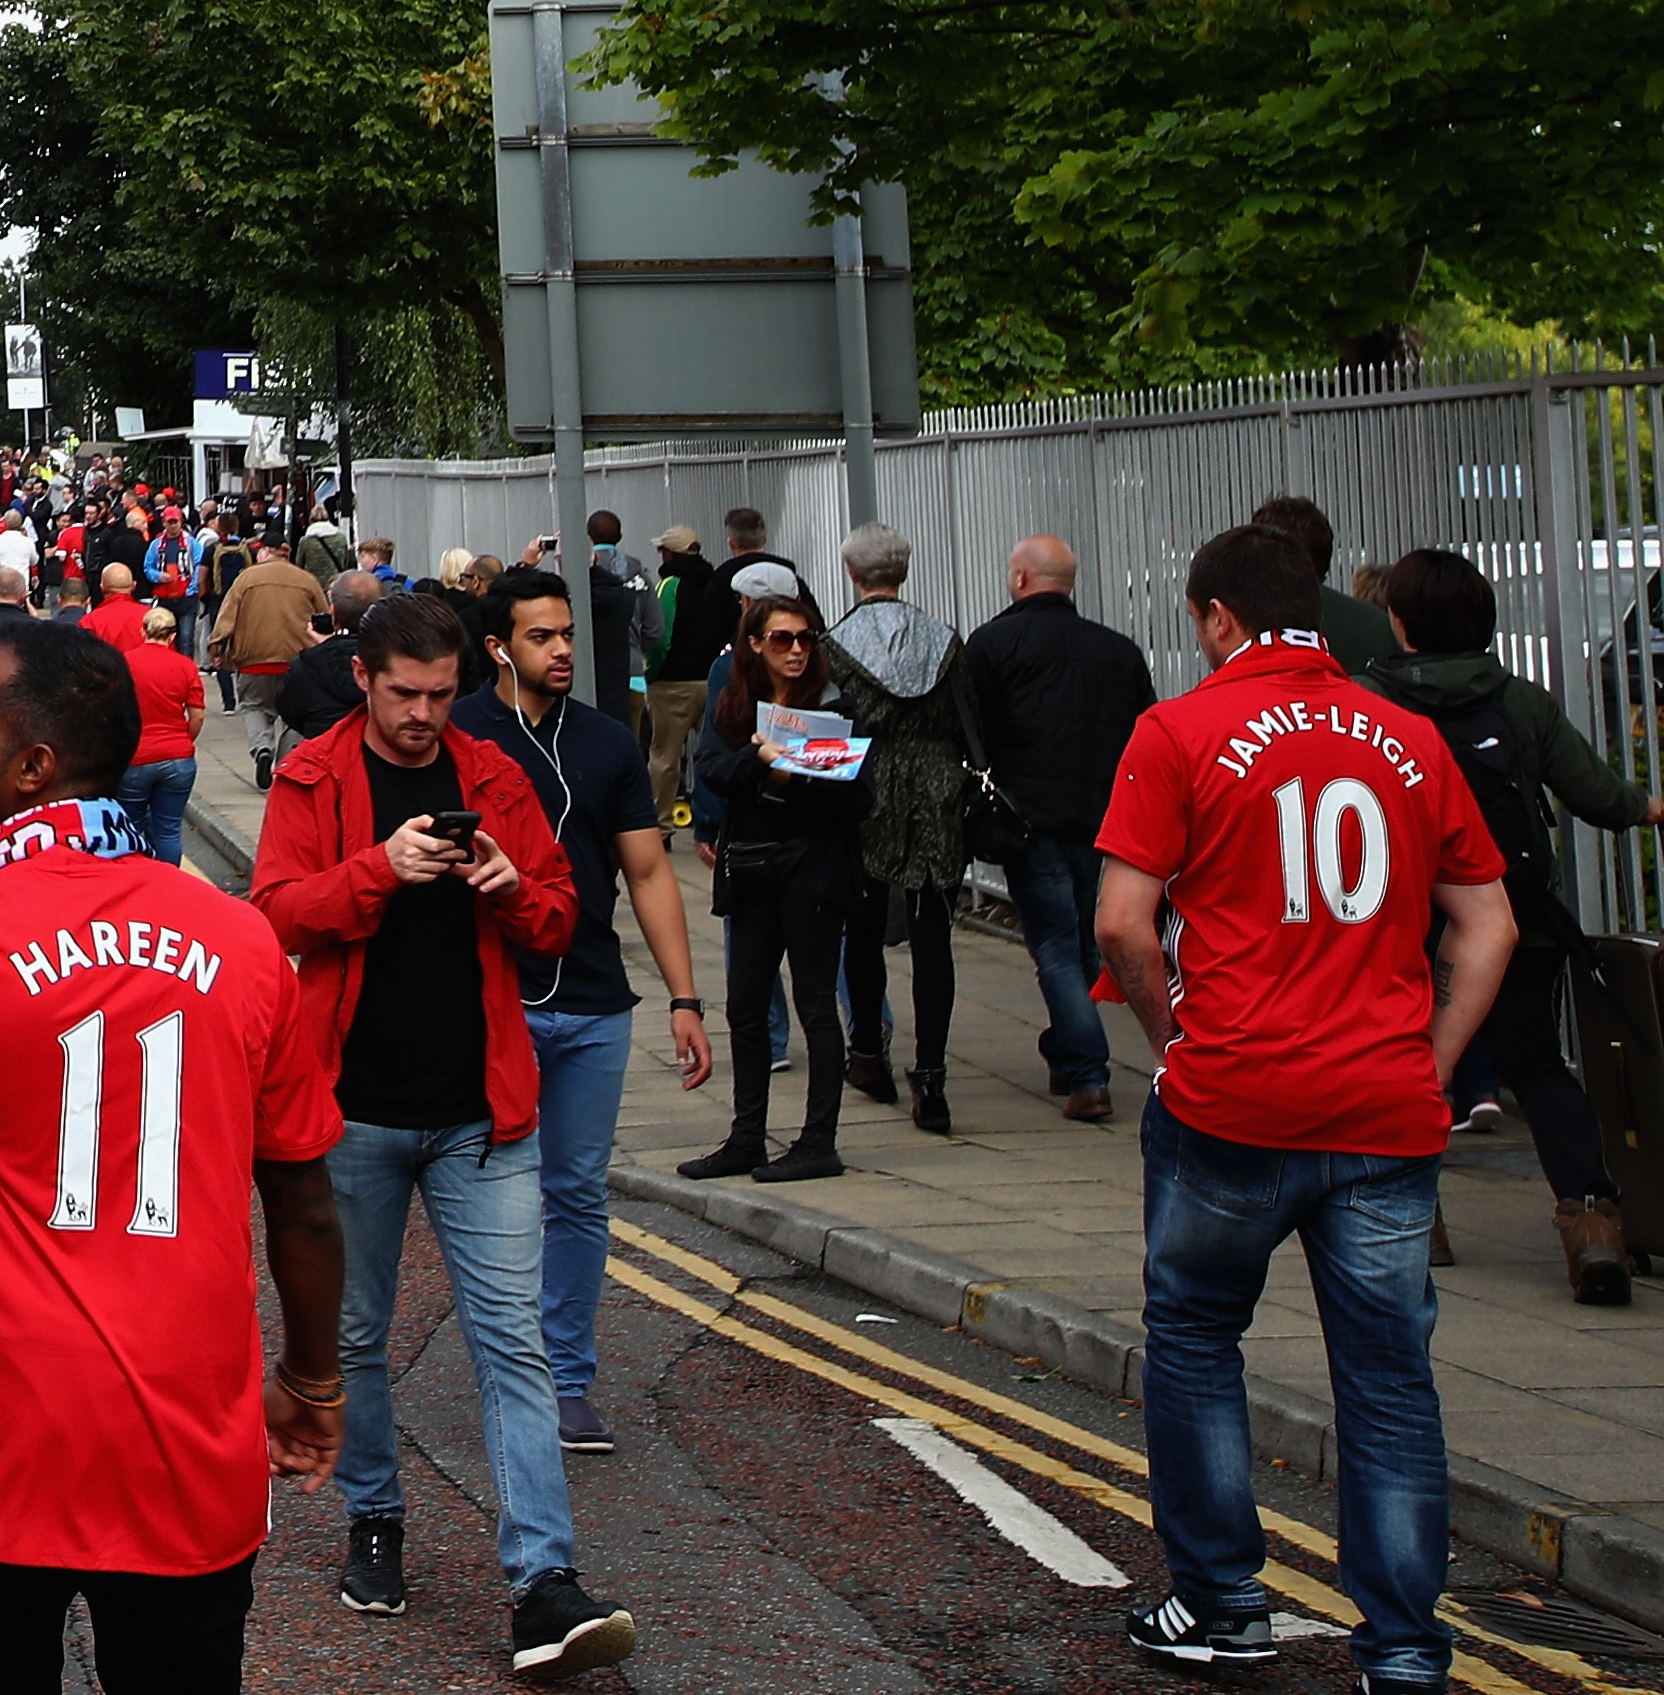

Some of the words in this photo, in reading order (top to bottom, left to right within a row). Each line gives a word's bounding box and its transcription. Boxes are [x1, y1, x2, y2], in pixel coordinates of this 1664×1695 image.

[1216, 701, 1424, 789] JAMIE-LEIGH
[1272, 776, 1390, 925] 10
[9, 920, 222, 996] HAREEN
[47, 1009, 184, 1237] 11
